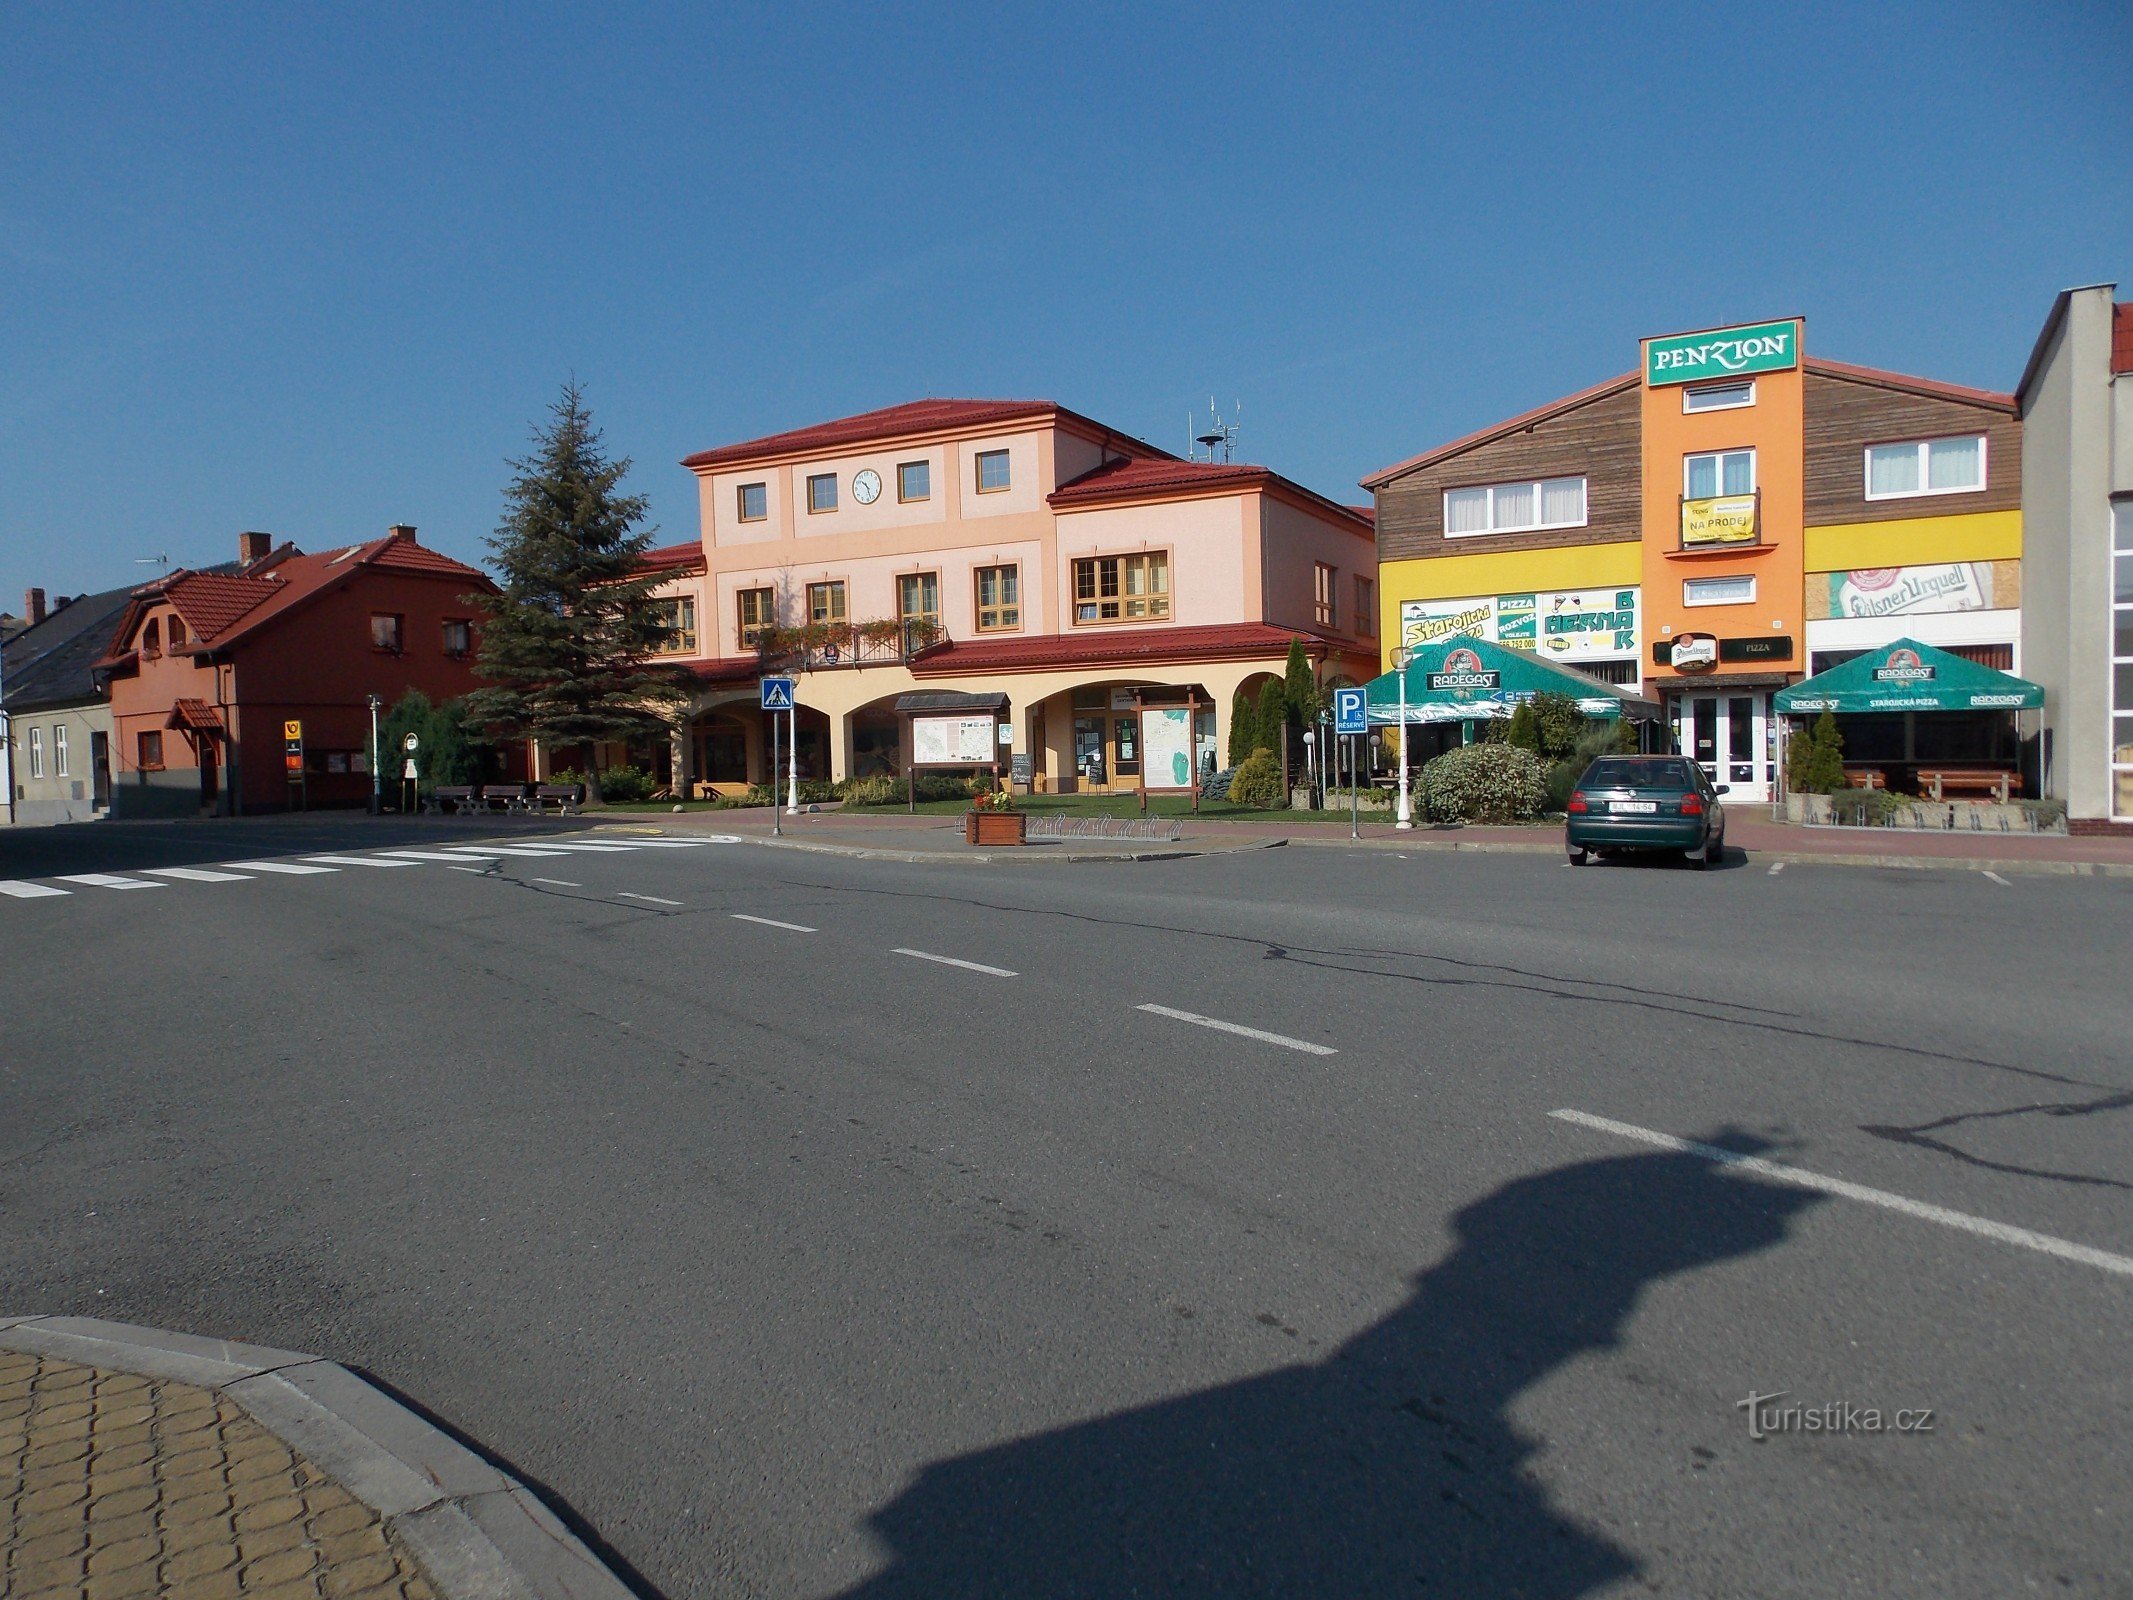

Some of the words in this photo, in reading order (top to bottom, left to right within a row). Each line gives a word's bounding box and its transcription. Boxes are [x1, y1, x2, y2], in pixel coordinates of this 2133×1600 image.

[1655, 334, 1788, 369] PENZION
[1690, 521, 1705, 530] NA
[1708, 516, 1747, 528] PRODEJ
[1850, 587, 1907, 617] Pilsner
[1903, 565, 1965, 598] Urquell
[1500, 599, 1534, 610] PIZZA
[1406, 605, 1491, 647] Starojická
[1498, 613, 1536, 633] ROZVOZ
[1524, 639, 1536, 648] 000
[1746, 644, 1770, 652] PIZZA
[1433, 673, 1495, 687] RADEGAST
[1877, 668, 1932, 679] RADEGAST
[1342, 694, 1360, 720] P
[1916, 698, 1939, 706] PIZZA
[1971, 695, 2025, 705] RADEGAST
